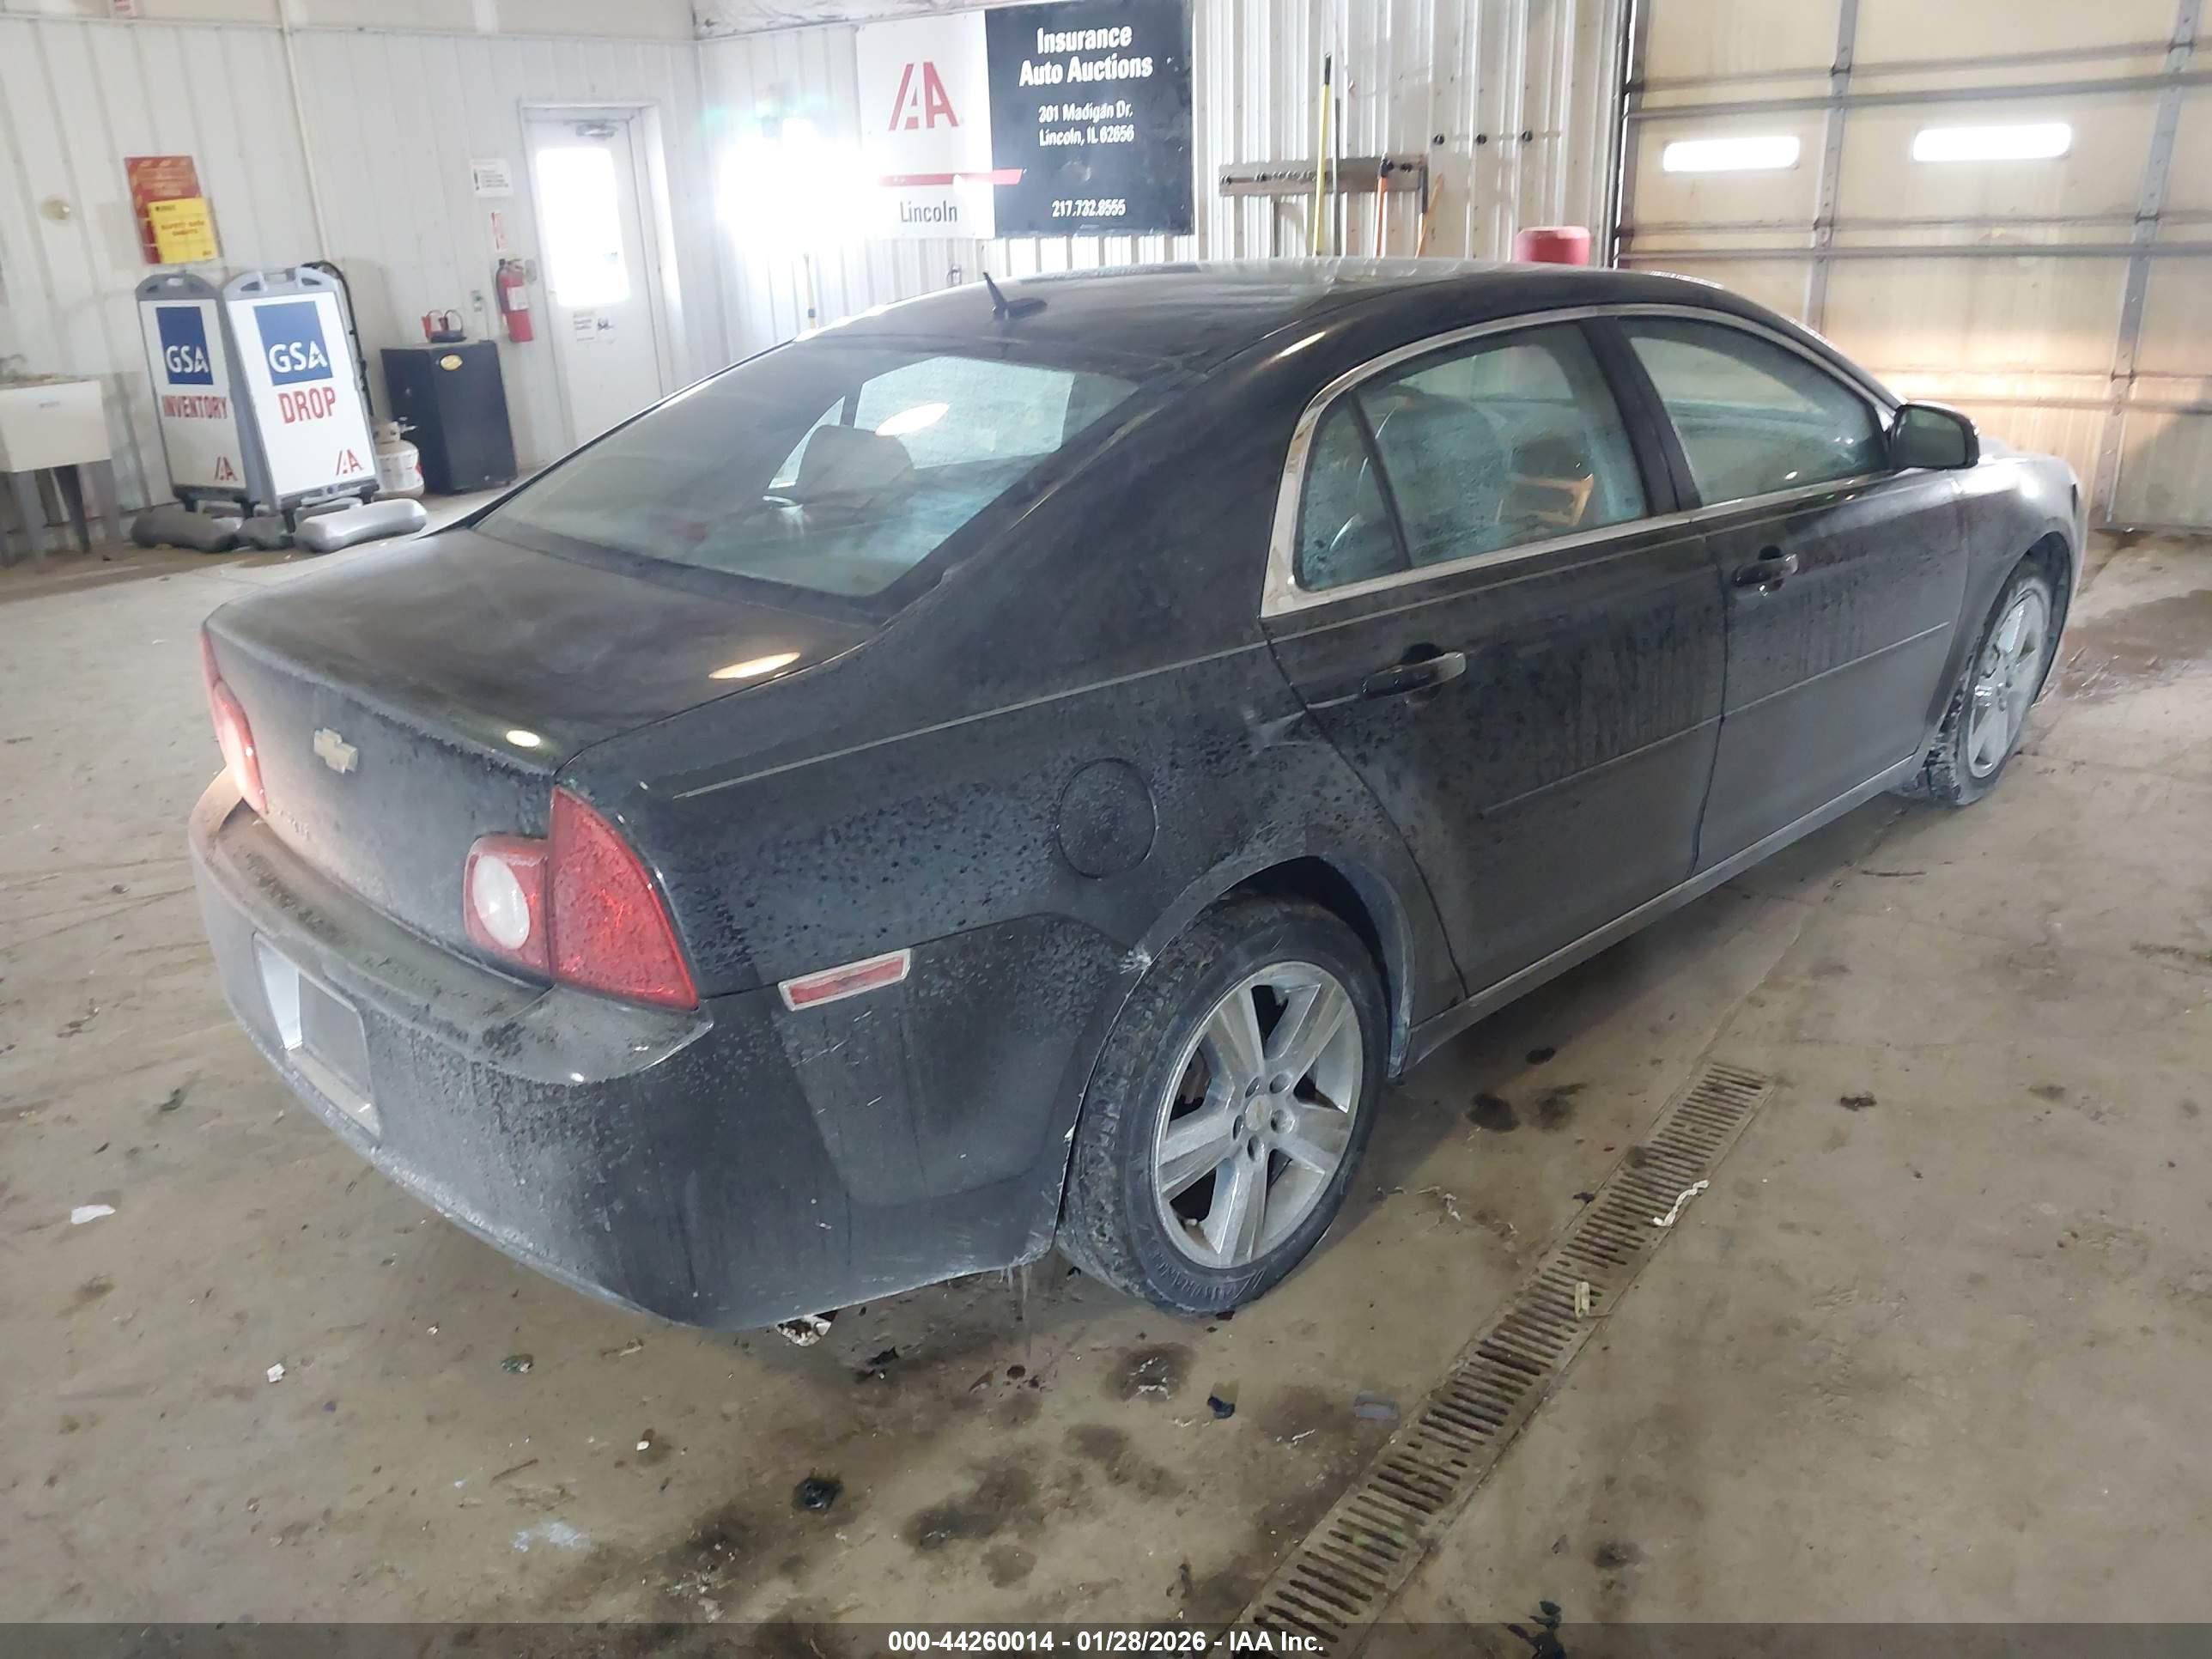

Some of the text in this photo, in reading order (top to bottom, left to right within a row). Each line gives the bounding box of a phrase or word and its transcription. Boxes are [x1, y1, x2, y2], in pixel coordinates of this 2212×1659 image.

[1037, 26, 1133, 54] Insurance
[1019, 52, 1153, 87] Auto Auctions
[1062, 102, 1115, 124] Madigan
[1039, 125, 1134, 146] Lincoln, IL 62656
[900, 199, 957, 222] Lincoln
[166, 345, 210, 374] GSA
[268, 340, 328, 373] GSA
[161, 394, 228, 419] INVENTORY
[277, 386, 336, 424] DROP
